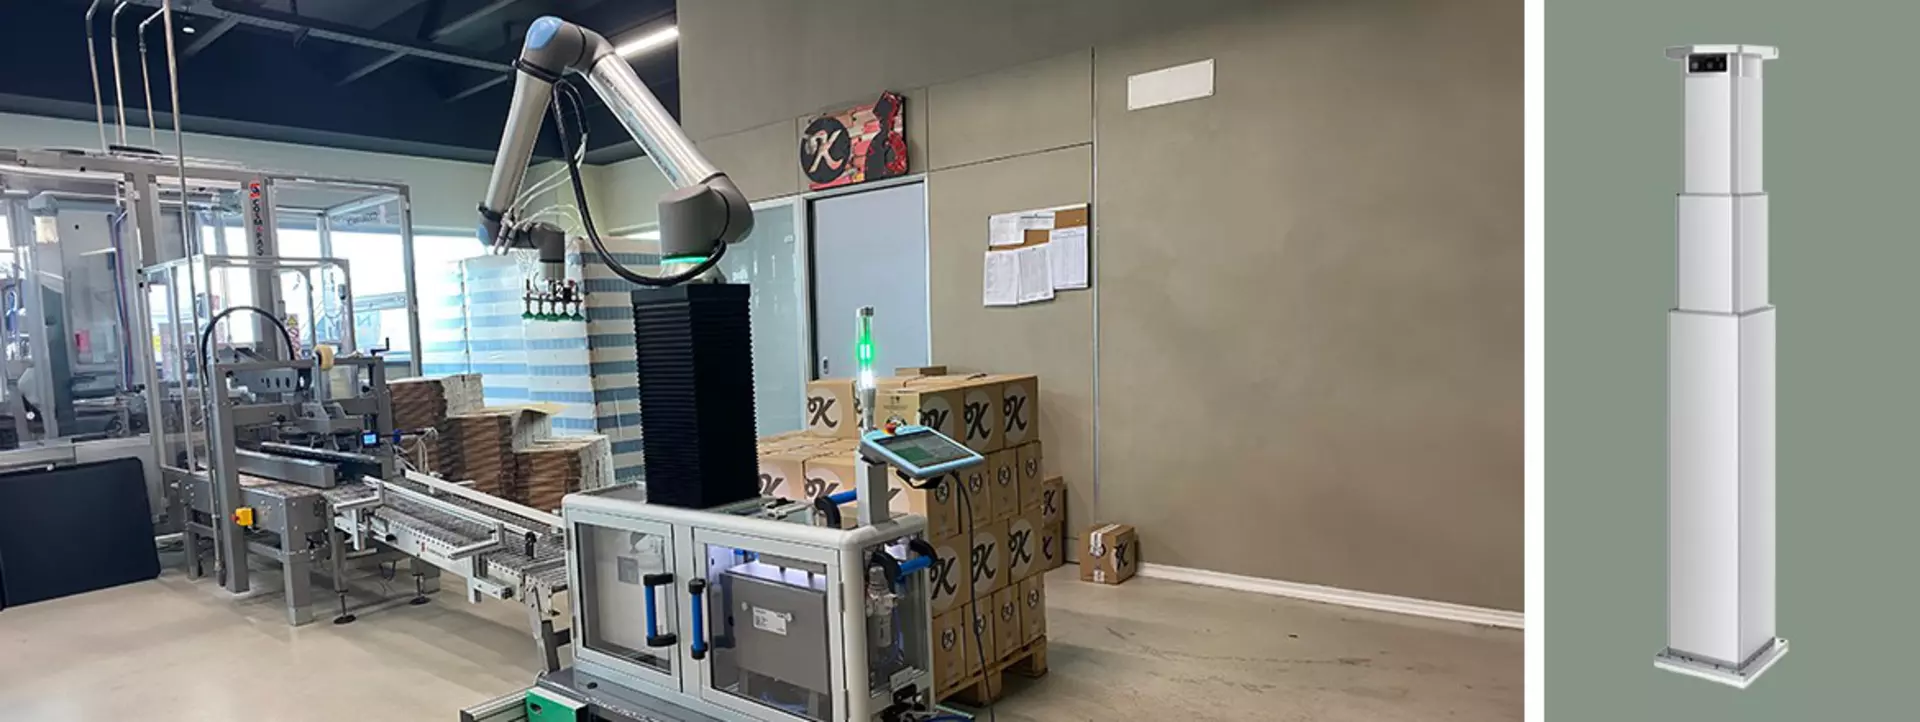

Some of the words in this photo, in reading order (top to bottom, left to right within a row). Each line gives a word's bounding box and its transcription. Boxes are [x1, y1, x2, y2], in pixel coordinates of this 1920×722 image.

[807, 396, 838, 428] K
[964, 402, 991, 441] K
[1003, 395, 1027, 433] K
[1008, 529, 1032, 569] K
